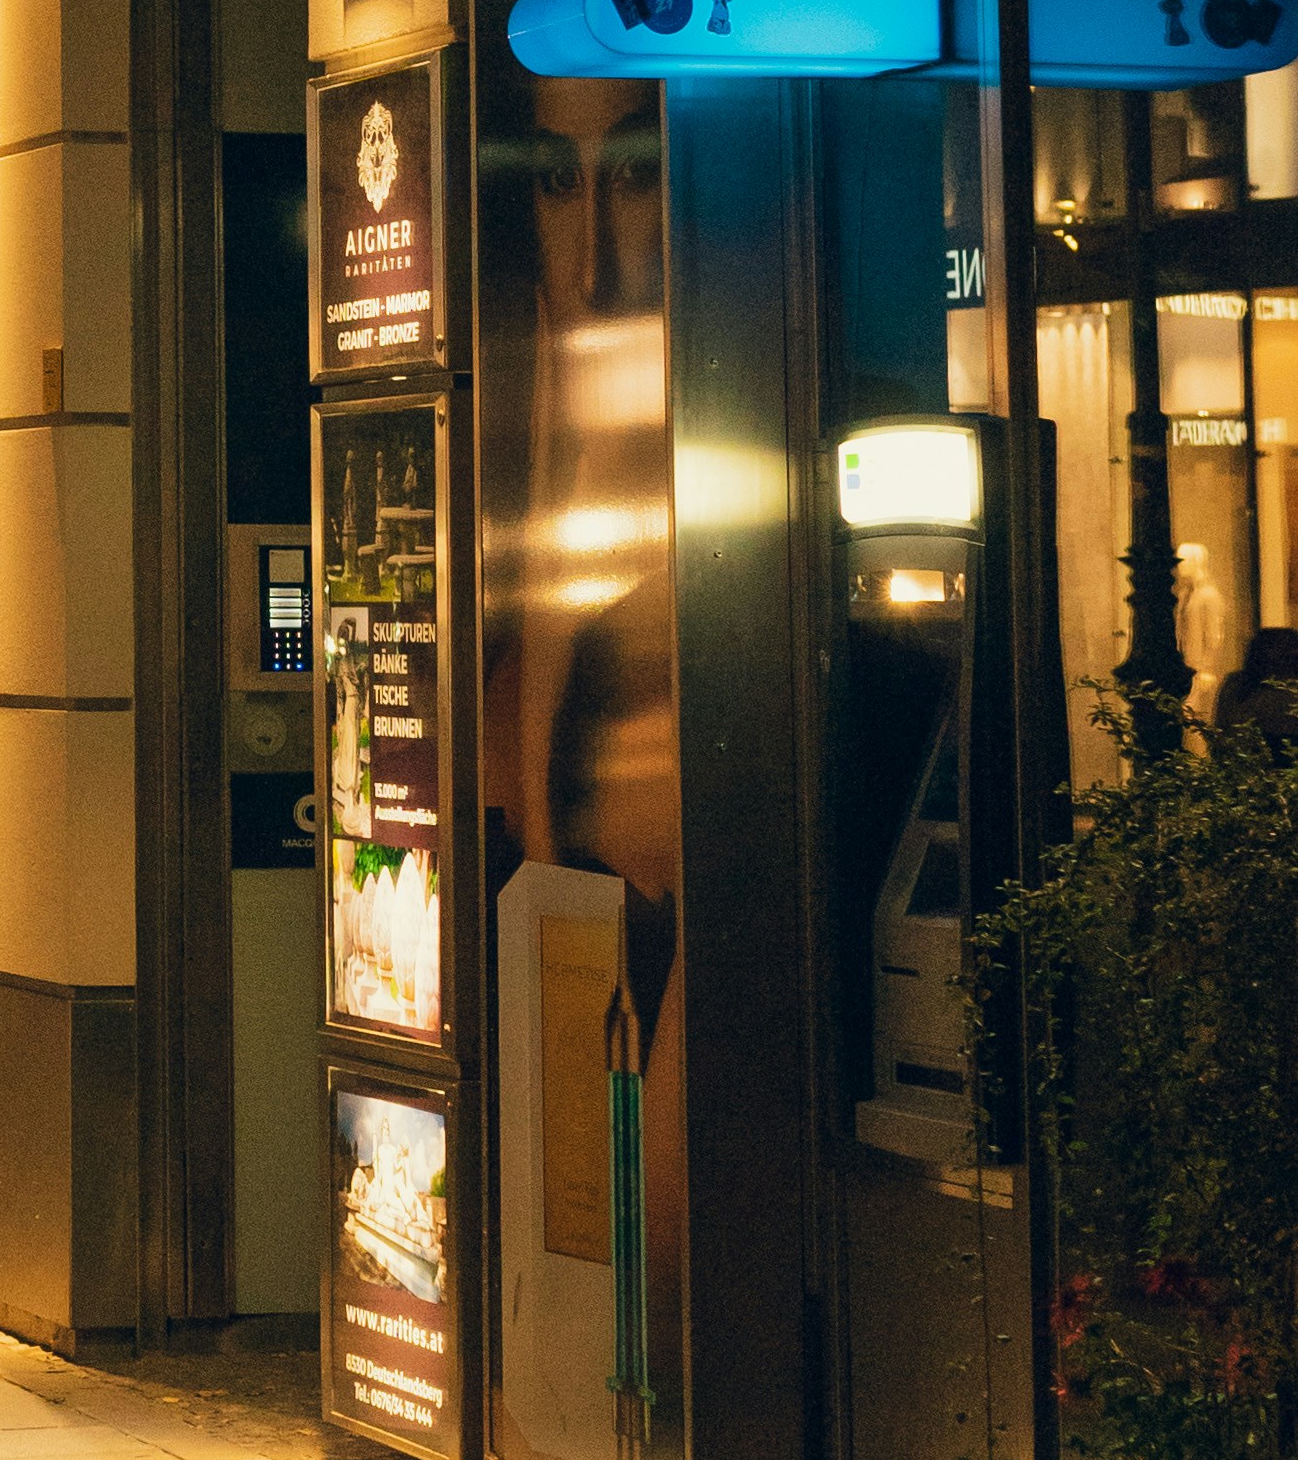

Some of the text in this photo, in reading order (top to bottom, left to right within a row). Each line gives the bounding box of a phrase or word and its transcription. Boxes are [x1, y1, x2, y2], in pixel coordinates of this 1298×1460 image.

[345, 220, 411, 257] AIGNER
[345, 255, 411, 277] RARITÄTEN
[327, 297, 380, 324] SANDSTEIN
[386, 290, 430, 315] MARMOR
[337, 328, 374, 351] GRANIT
[379, 322, 420, 346] BRONZE
[373, 623, 436, 643] SKULPTUREN
[373, 649, 408, 674] BÄNKE
[373, 685, 409, 706] TISCHE
[374, 716, 423, 738] BRUNNEN
[345, 1304, 444, 1354] www.rarities.at
